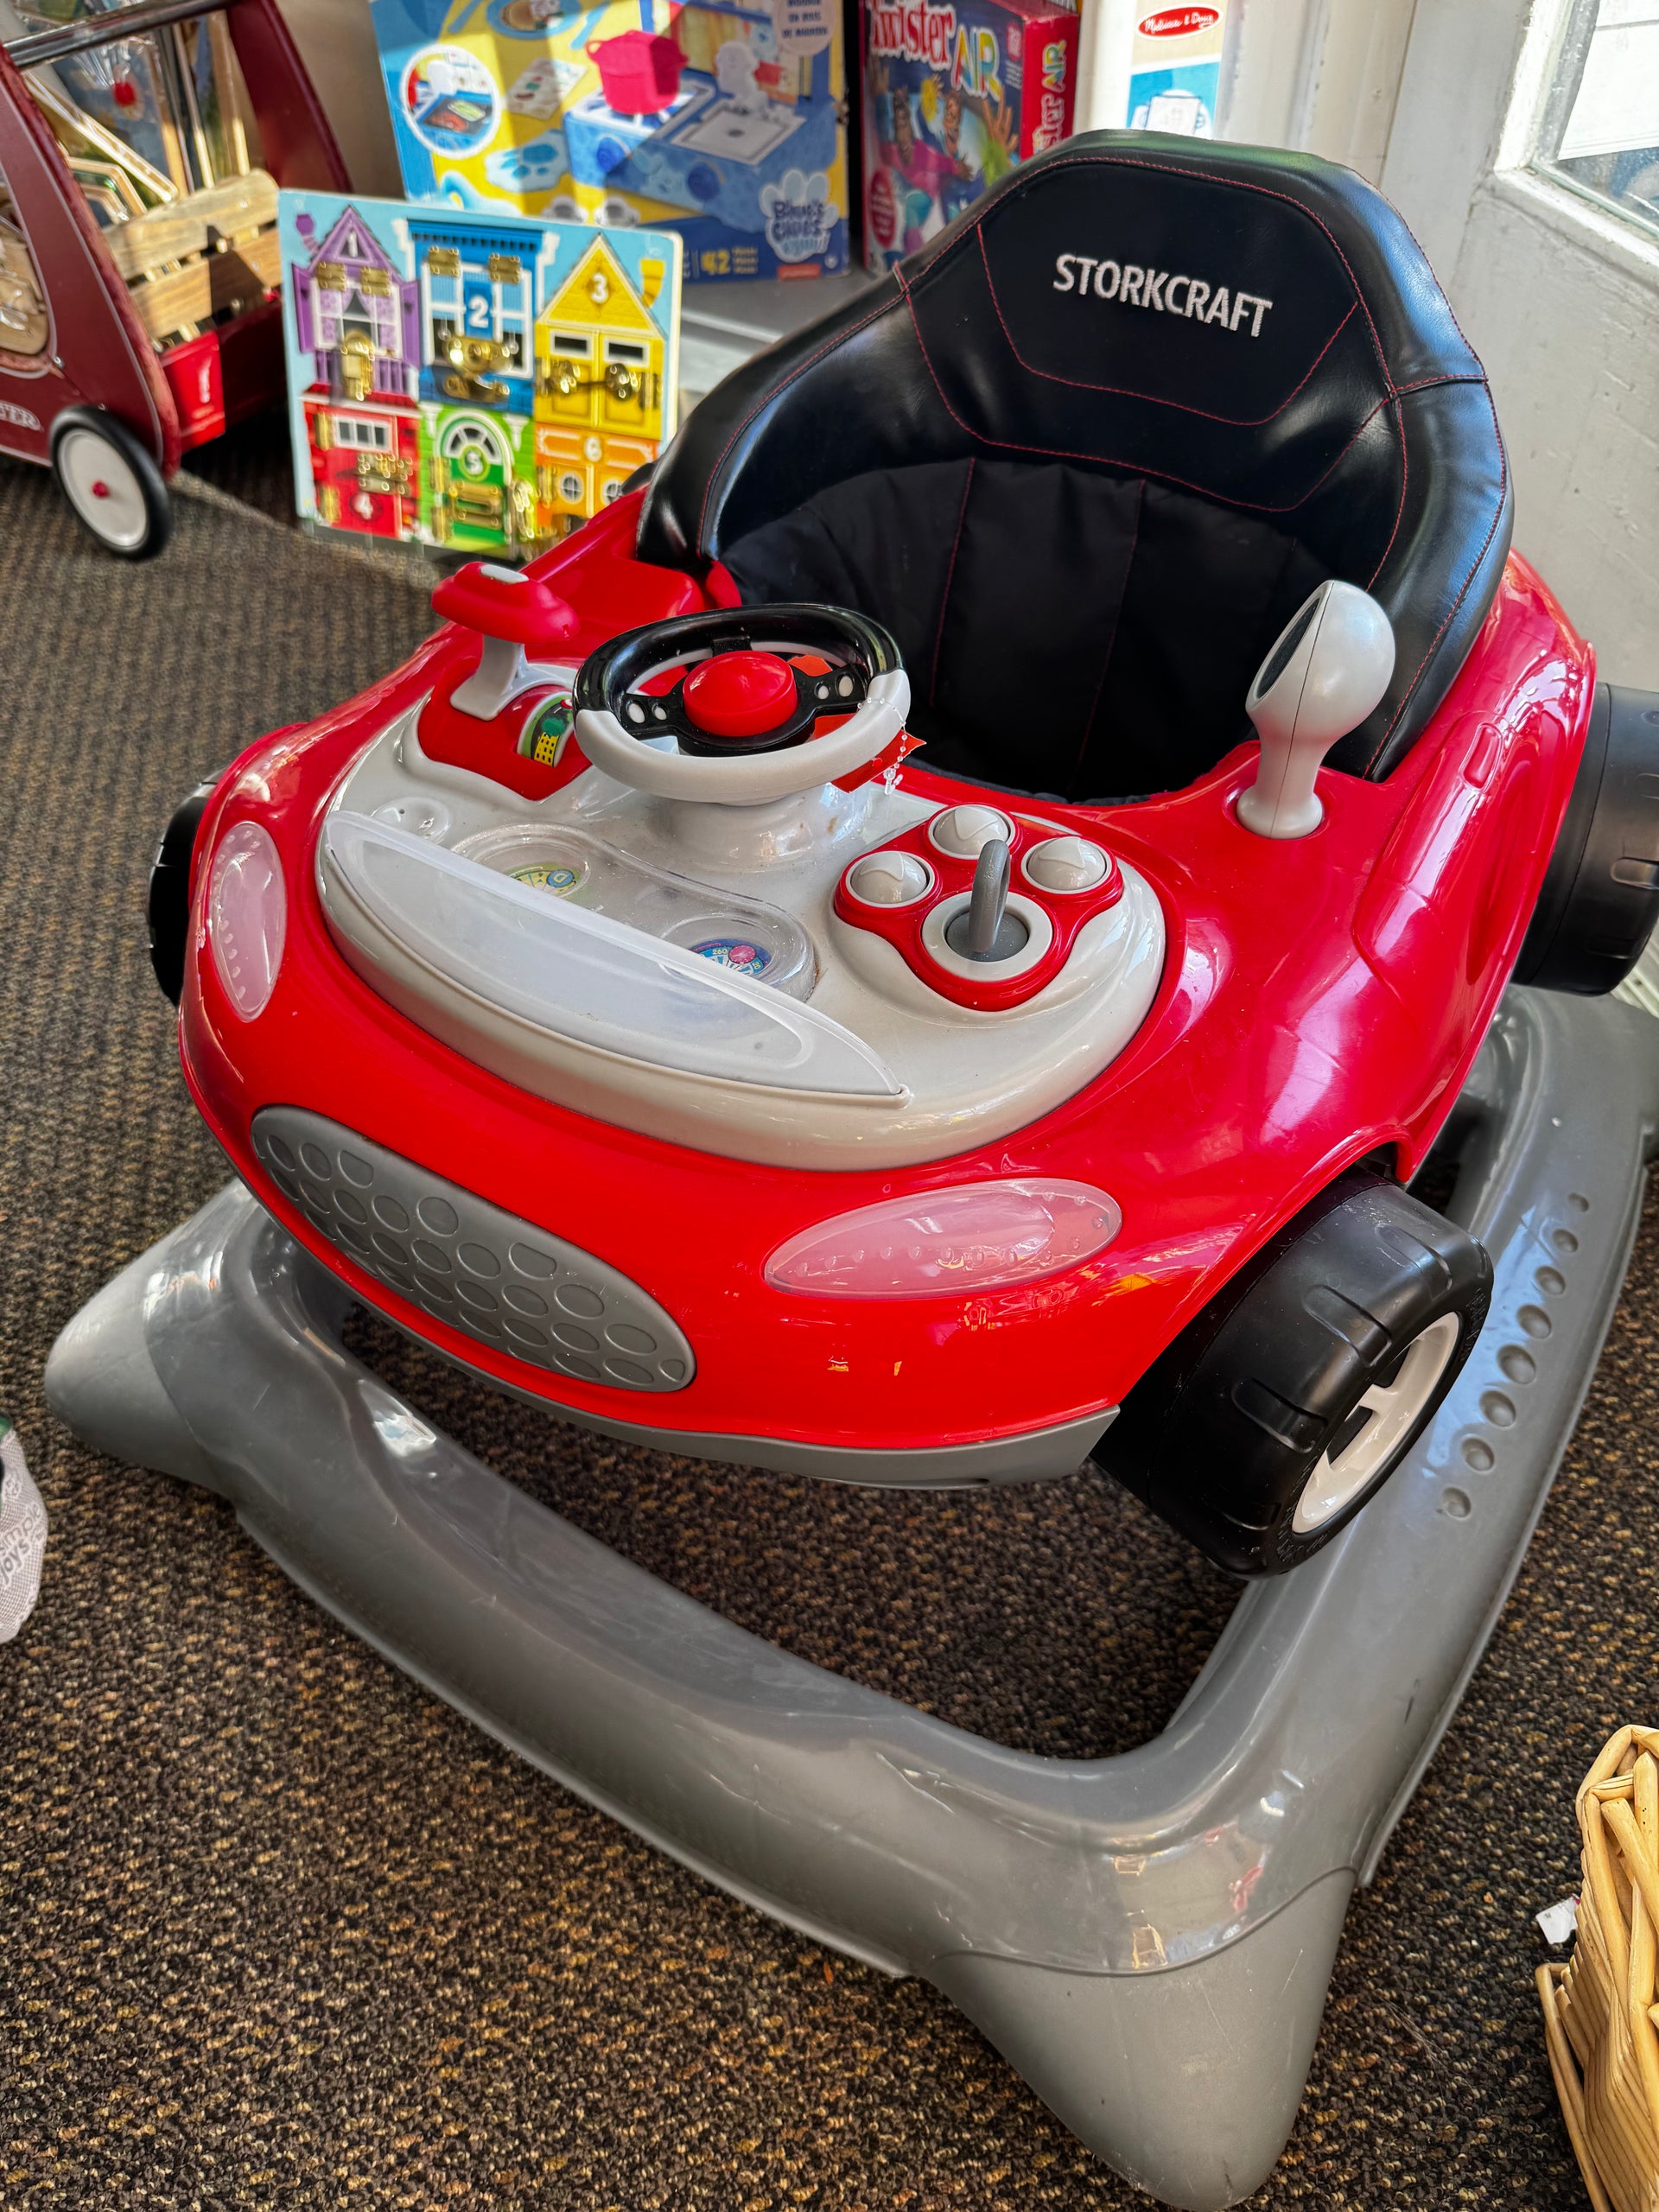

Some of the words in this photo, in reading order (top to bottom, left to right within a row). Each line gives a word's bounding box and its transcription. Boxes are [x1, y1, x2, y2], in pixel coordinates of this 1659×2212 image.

[953, 28, 1001, 99] AIR
[1043, 41, 1065, 92] AIR
[347, 231, 359, 257] 1
[590, 273, 608, 303] 3
[1052, 254, 1274, 338] STORKCRAFT
[468, 295, 489, 328] 2
[584, 435, 602, 462] 6
[354, 493, 374, 520] 4
